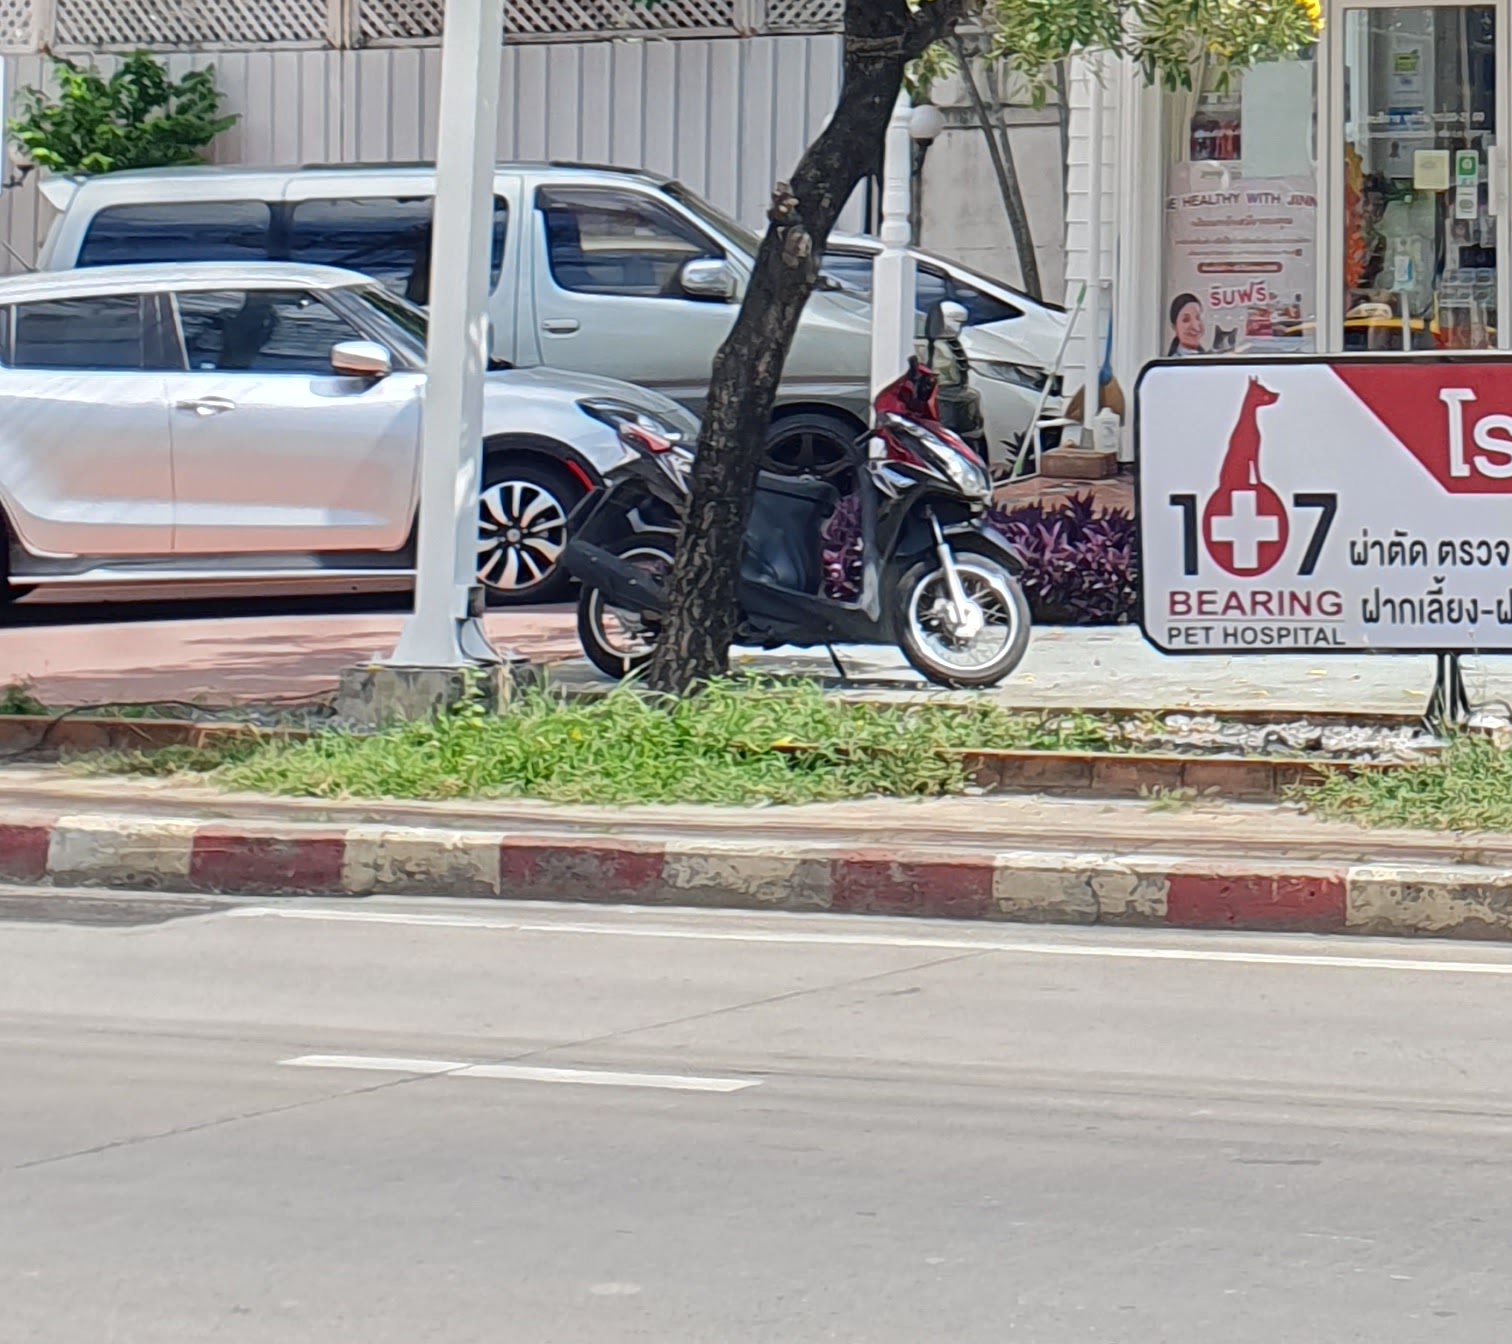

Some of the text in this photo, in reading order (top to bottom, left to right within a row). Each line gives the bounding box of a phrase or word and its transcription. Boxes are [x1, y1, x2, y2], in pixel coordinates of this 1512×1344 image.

[1182, 193, 1241, 208] HEALTHY
[1246, 192, 1281, 206] WITH
[1349, 527, 1428, 568] ผ่าตัด
[1168, 590, 1343, 618] BEARING
[1168, 625, 1347, 647] PET HOSPITAL
